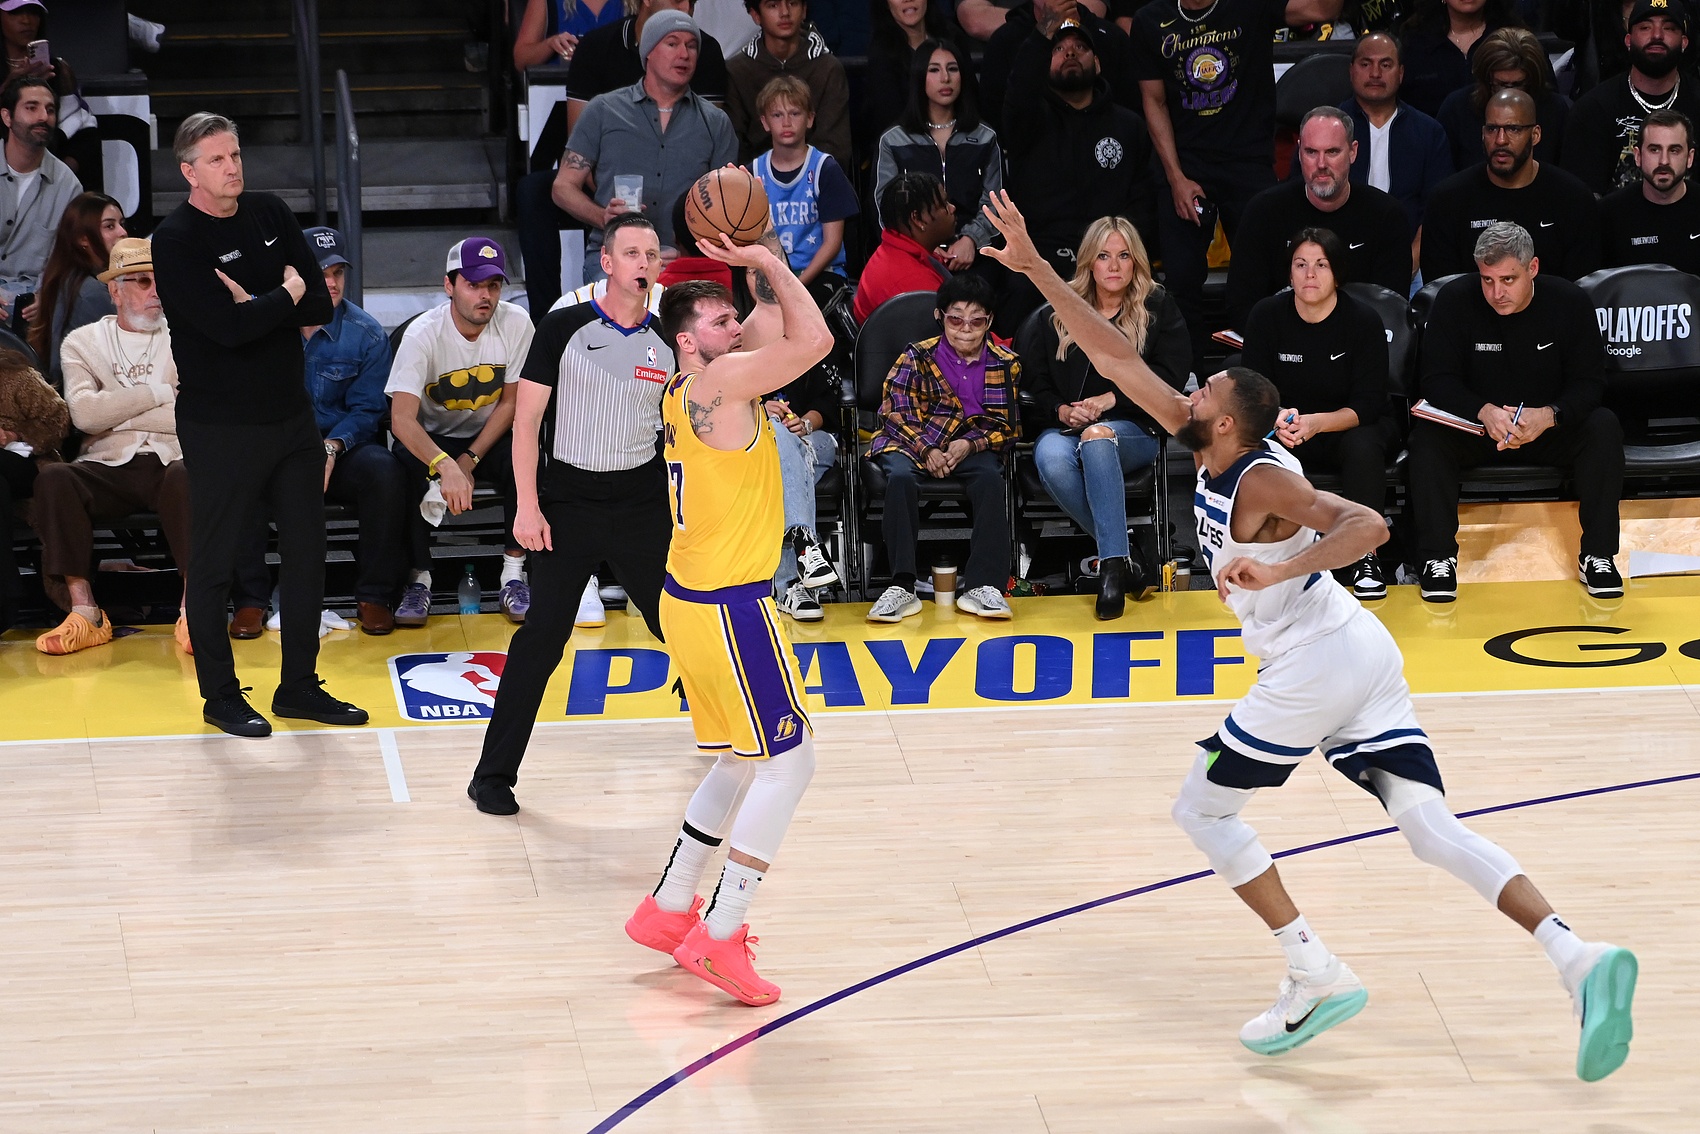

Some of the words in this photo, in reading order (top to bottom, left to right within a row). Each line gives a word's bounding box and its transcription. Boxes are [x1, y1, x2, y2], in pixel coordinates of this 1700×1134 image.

[1162, 27, 1242, 58] Champions
[1595, 303, 1692, 343] PLAYOFFS
[1606, 344, 1642, 358] Google
[635, 368, 666, 382] Emirates
[565, 628, 1245, 715] PAYOFF
[420, 704, 481, 717] NBA
